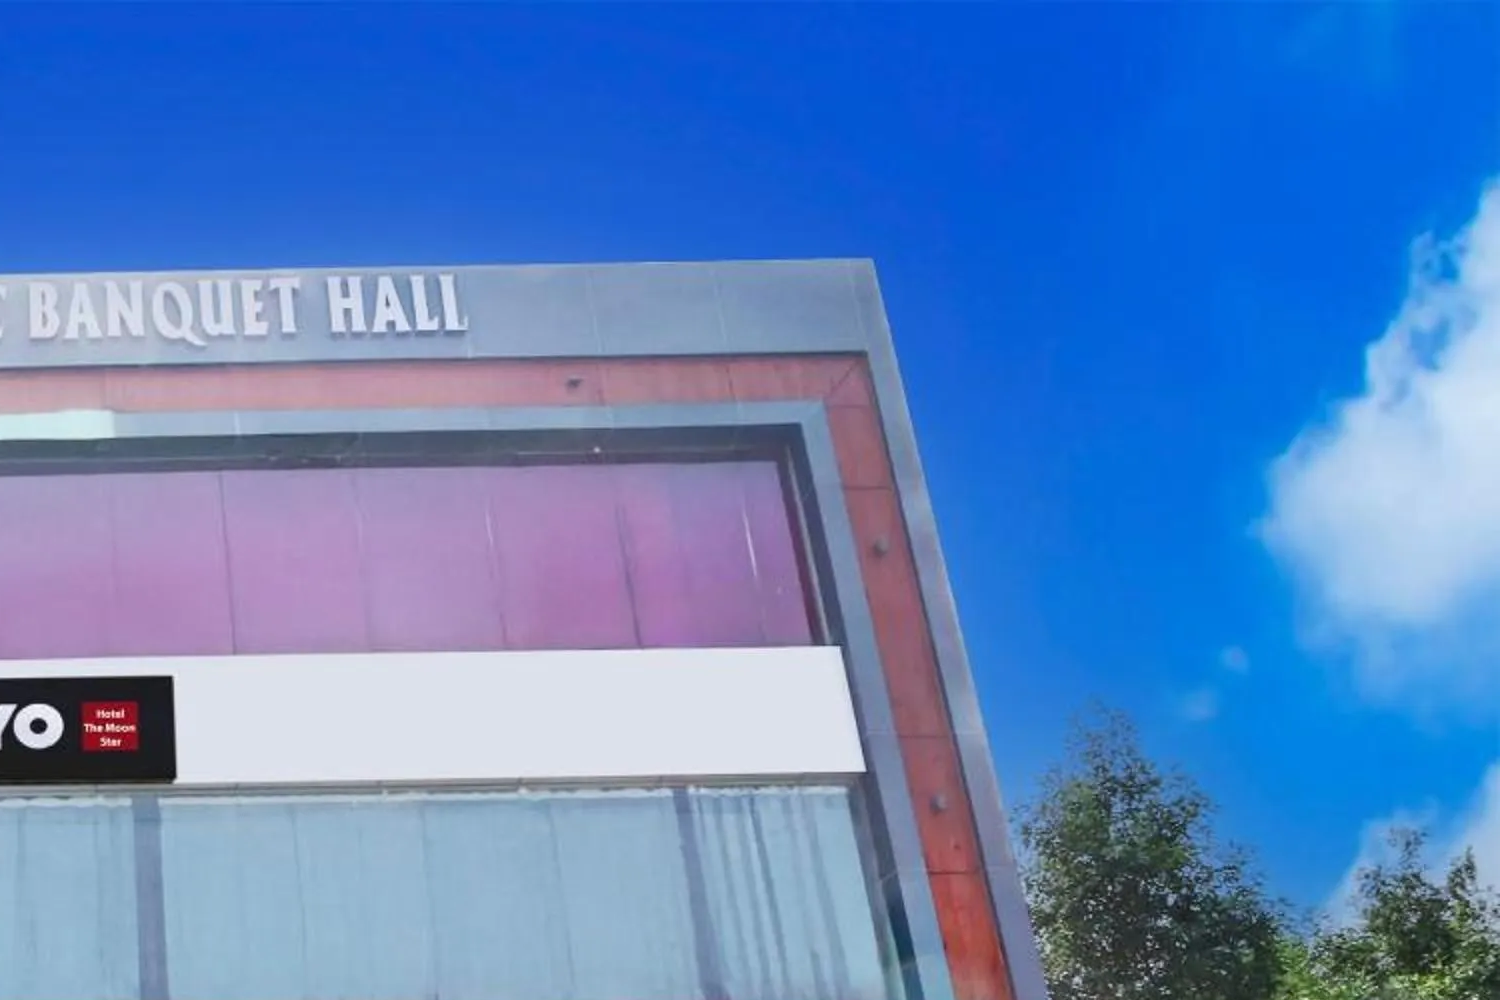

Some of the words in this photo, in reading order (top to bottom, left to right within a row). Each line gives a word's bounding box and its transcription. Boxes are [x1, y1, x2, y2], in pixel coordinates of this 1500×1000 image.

[28, 277, 300, 347] BANQUET
[325, 274, 469, 334] HALL
[96, 708, 125, 719] Hotel
[83, 723, 103, 733] The
[105, 723, 137, 733] Moon
[100, 737, 121, 747] Star
